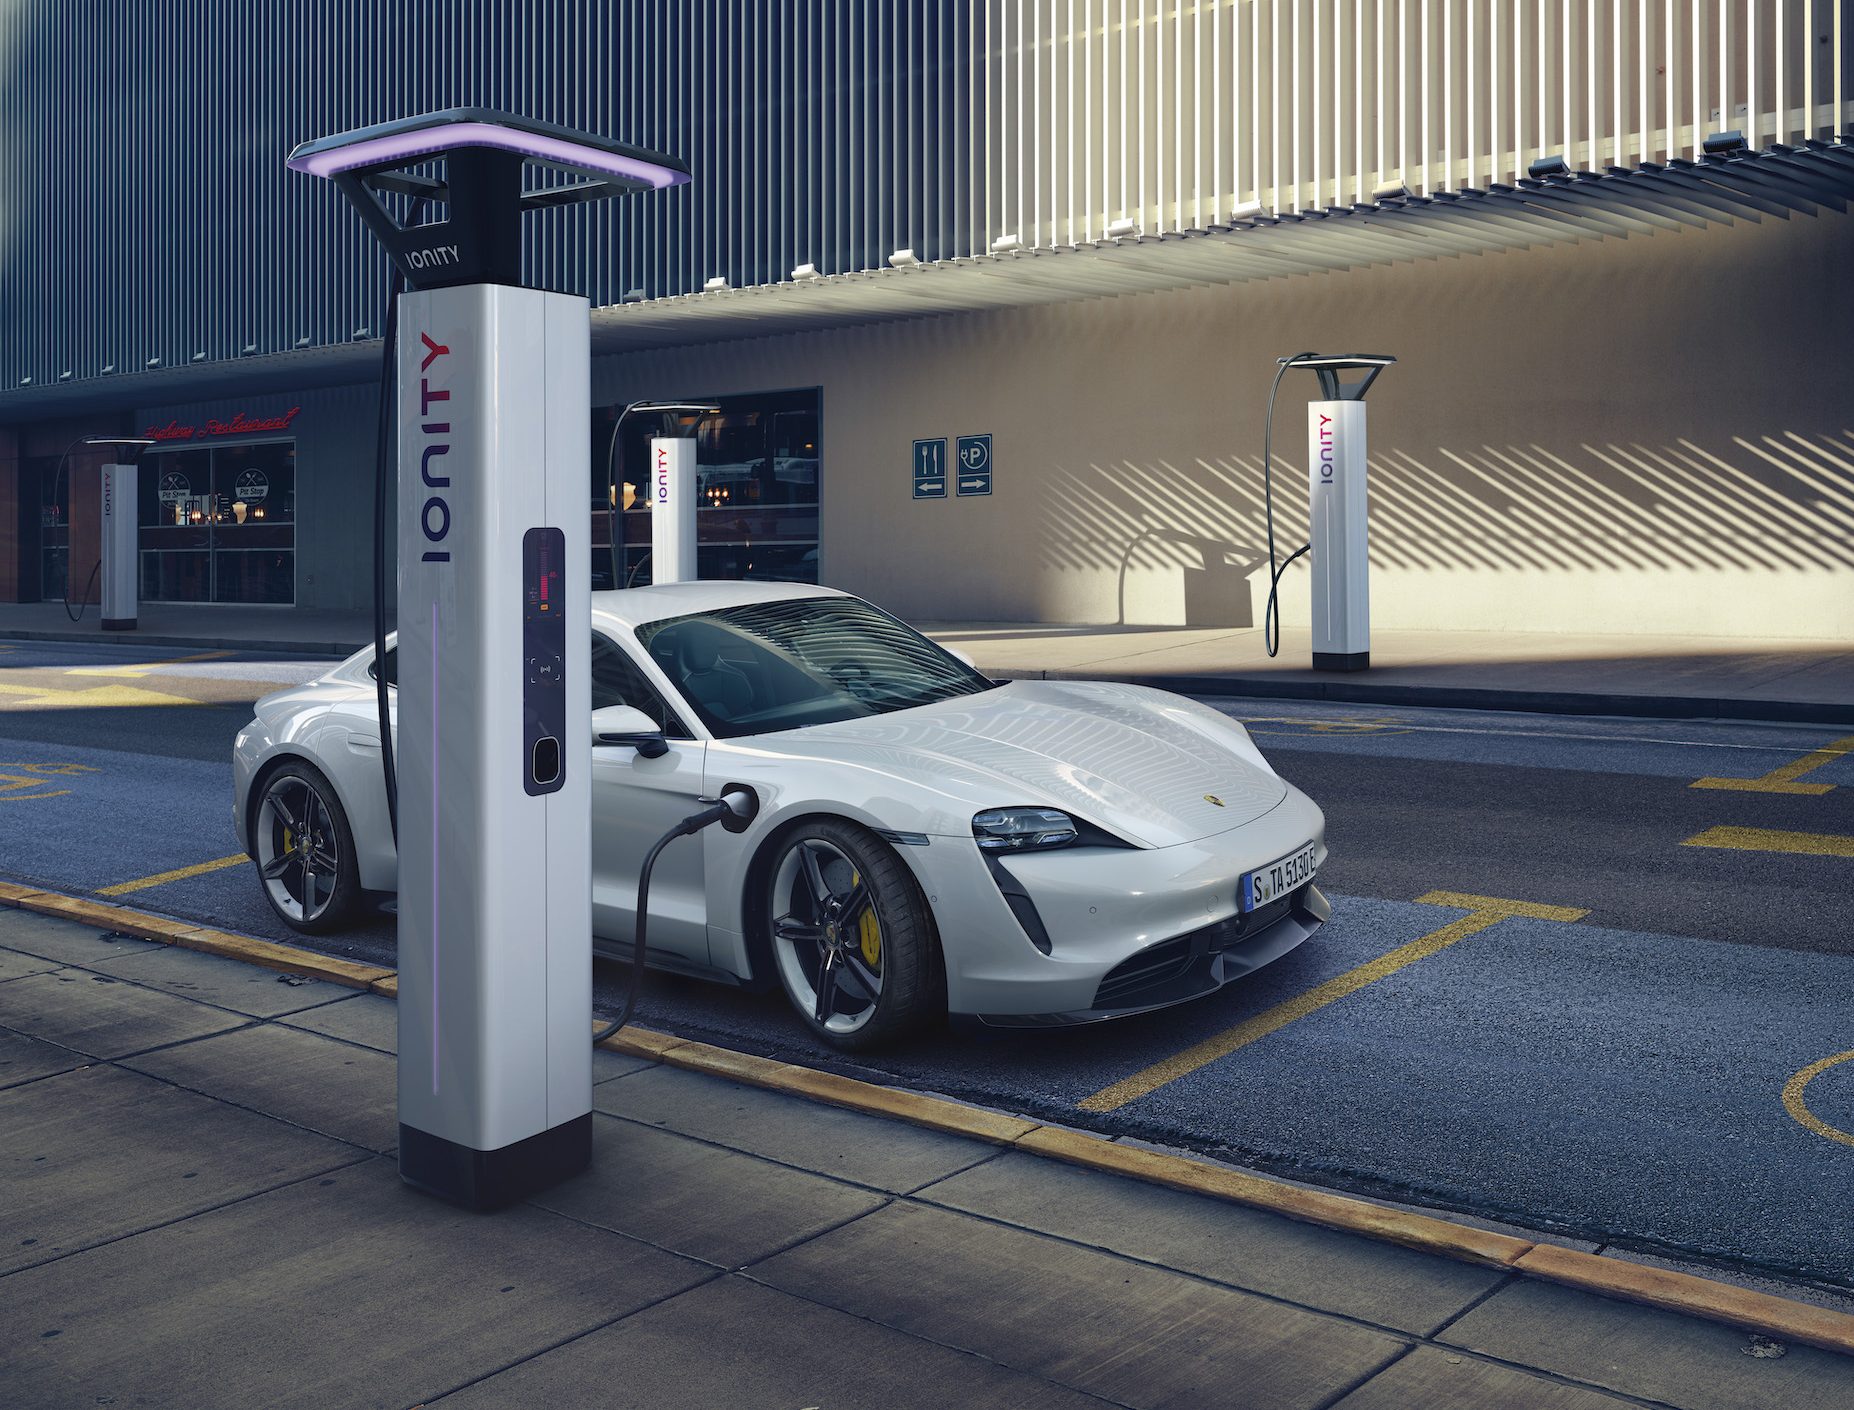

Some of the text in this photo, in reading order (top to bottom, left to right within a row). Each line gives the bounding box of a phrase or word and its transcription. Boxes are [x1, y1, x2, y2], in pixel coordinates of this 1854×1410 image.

[404, 244, 460, 270] IONITY
[421, 331, 451, 562] IONITY
[969, 448, 981, 464] P
[1320, 414, 1333, 484] IONITY
[658, 448, 668, 503] IONITY
[1254, 876, 1263, 903] S
[1270, 866, 1284, 895] TA
